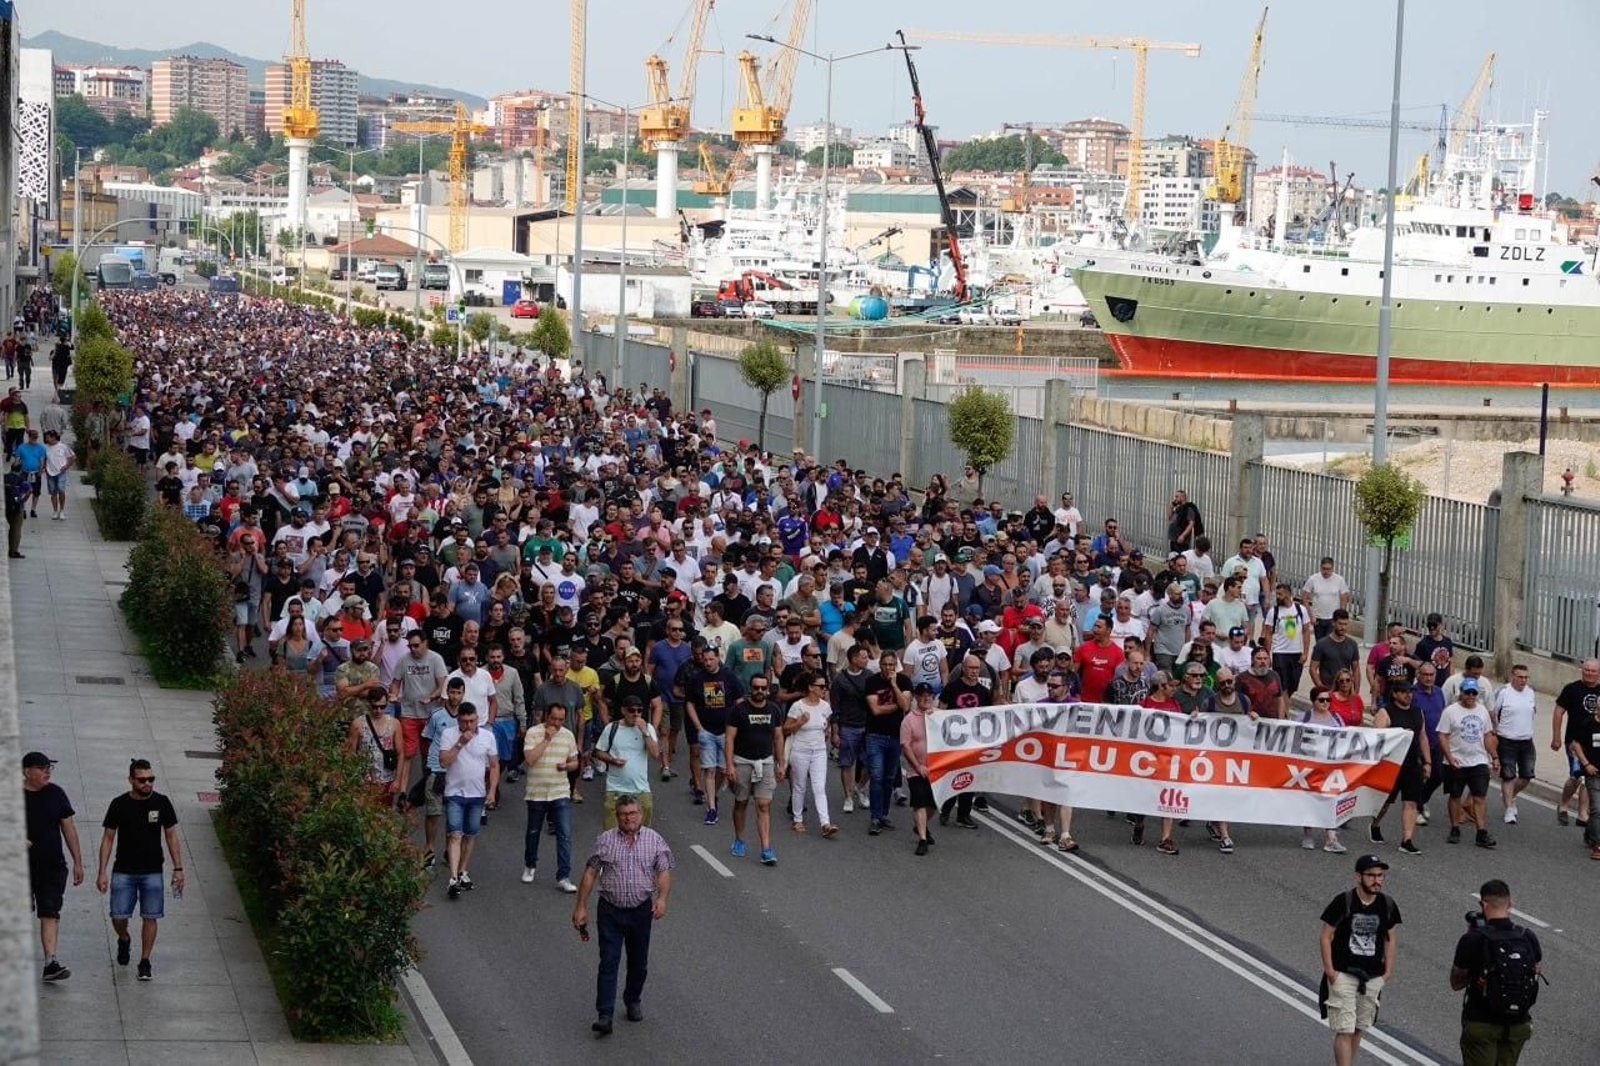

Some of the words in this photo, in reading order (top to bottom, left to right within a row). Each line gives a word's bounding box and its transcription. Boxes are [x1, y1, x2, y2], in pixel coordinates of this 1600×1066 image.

[941, 704, 1172, 747] CONVENIO
[1184, 716, 1239, 748] DO
[978, 737, 1251, 785] SOLUCIÓN
[1283, 764, 1349, 792] XA
[1159, 787, 1190, 808] CIG
